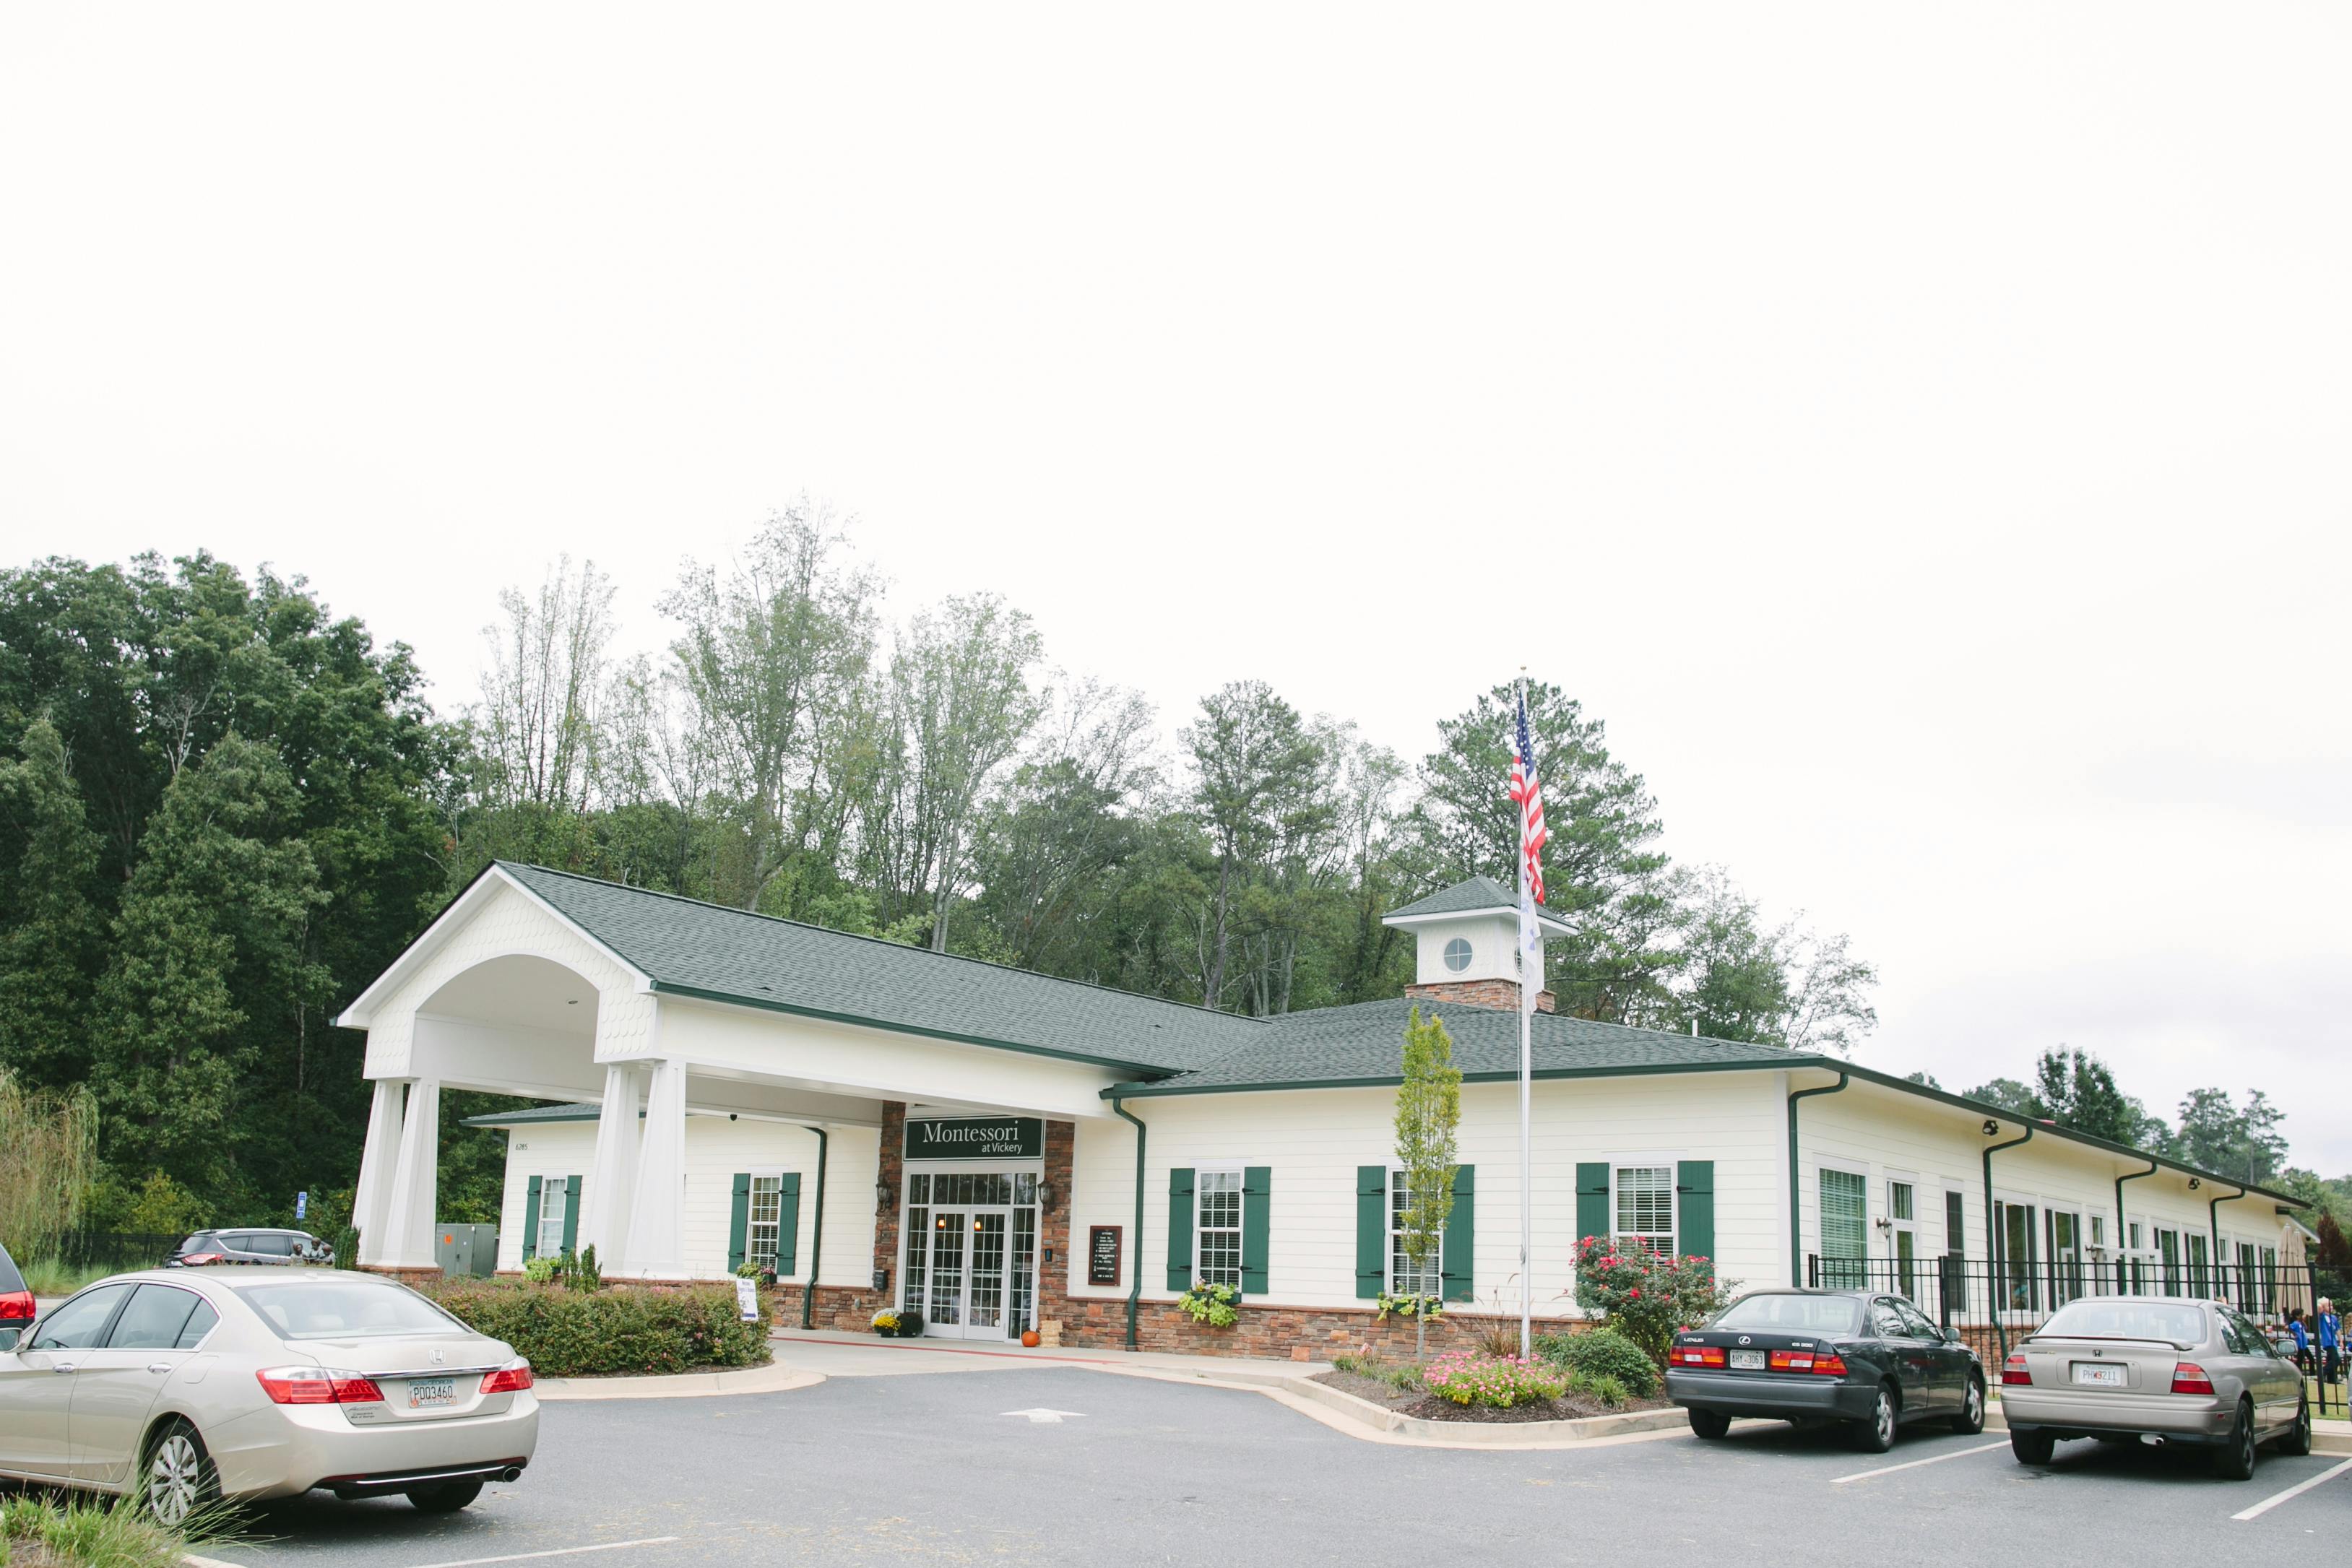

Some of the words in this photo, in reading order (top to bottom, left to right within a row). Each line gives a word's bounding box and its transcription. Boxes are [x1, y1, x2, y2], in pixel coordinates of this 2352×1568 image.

[922, 1120, 1019, 1143] Montessori
[982, 1144, 990, 1153] at
[992, 1143, 1023, 1154] Vickery
[413, 1385, 453, 1400] PDQ3460
